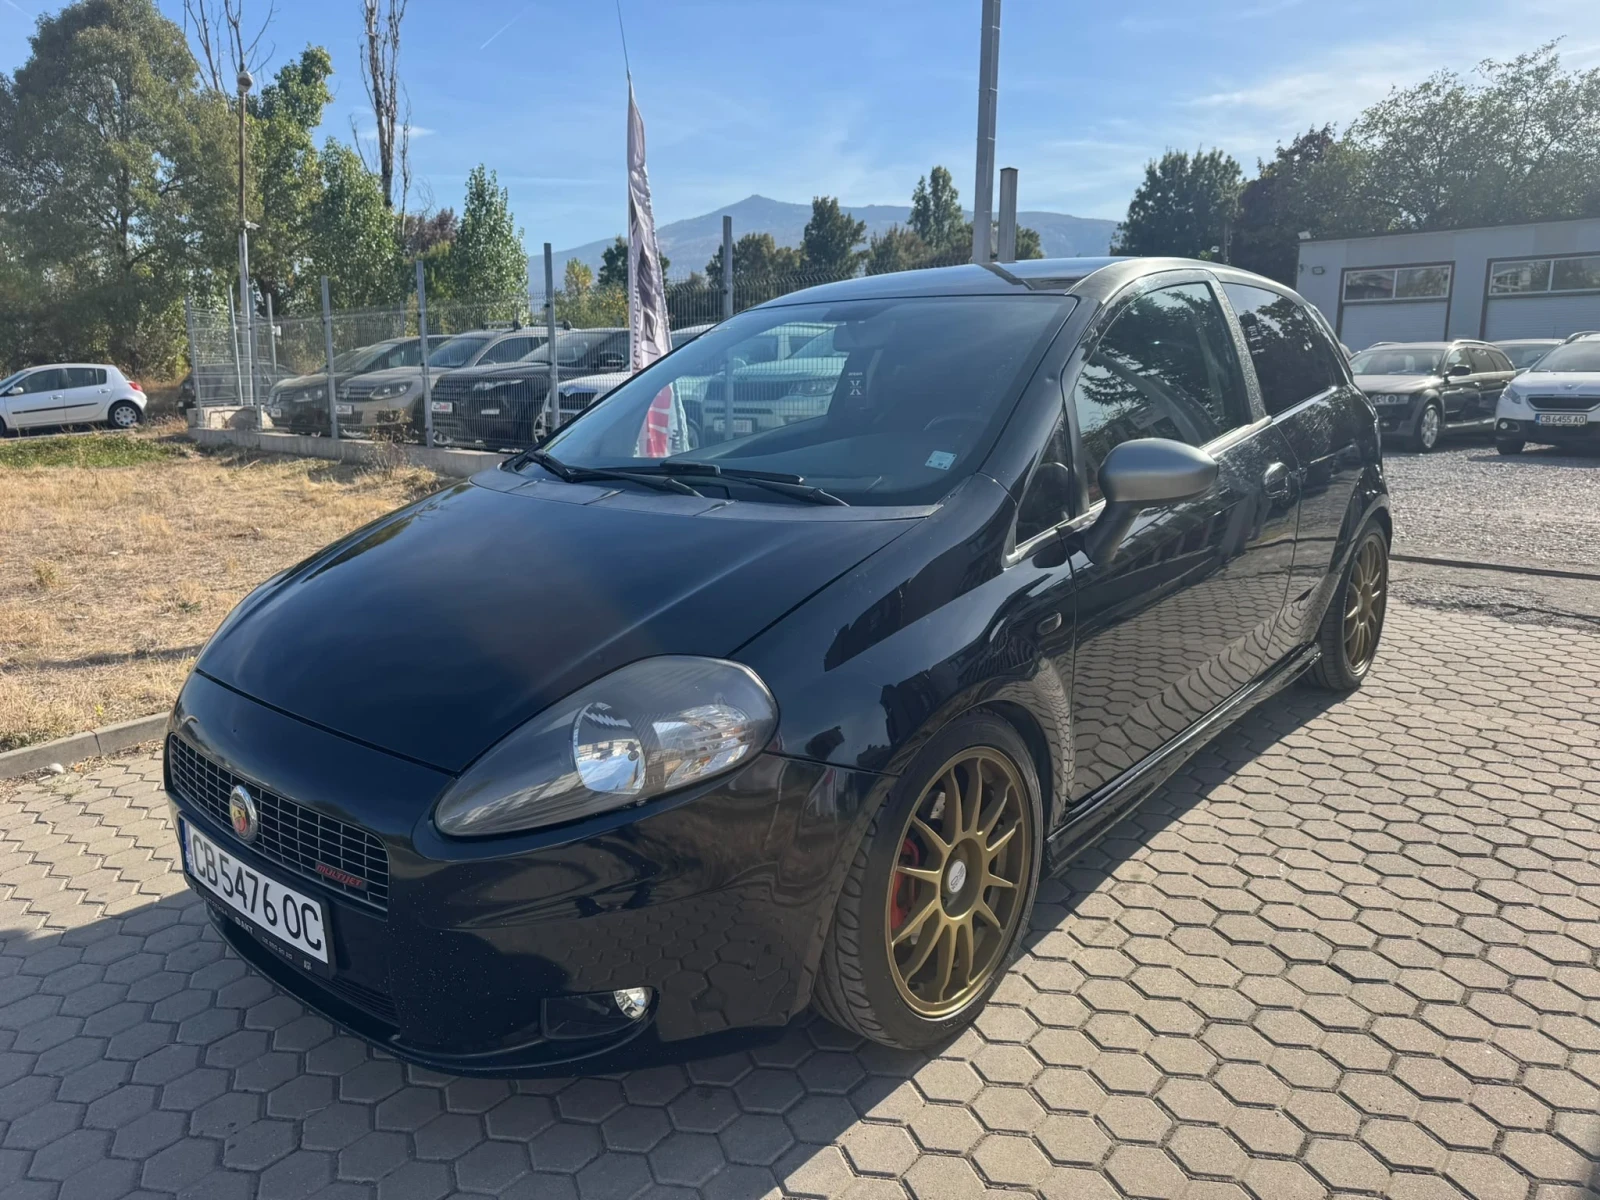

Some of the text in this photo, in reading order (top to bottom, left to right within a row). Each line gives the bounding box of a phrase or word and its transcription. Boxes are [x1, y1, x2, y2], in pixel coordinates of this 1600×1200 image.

[1540, 415, 1551, 424] CB
[1552, 415, 1572, 424] 6455
[316, 863, 363, 887] MULTIJET
[192, 833, 218, 887] CB
[219, 852, 278, 927] 5476
[283, 893, 322, 951] OC
